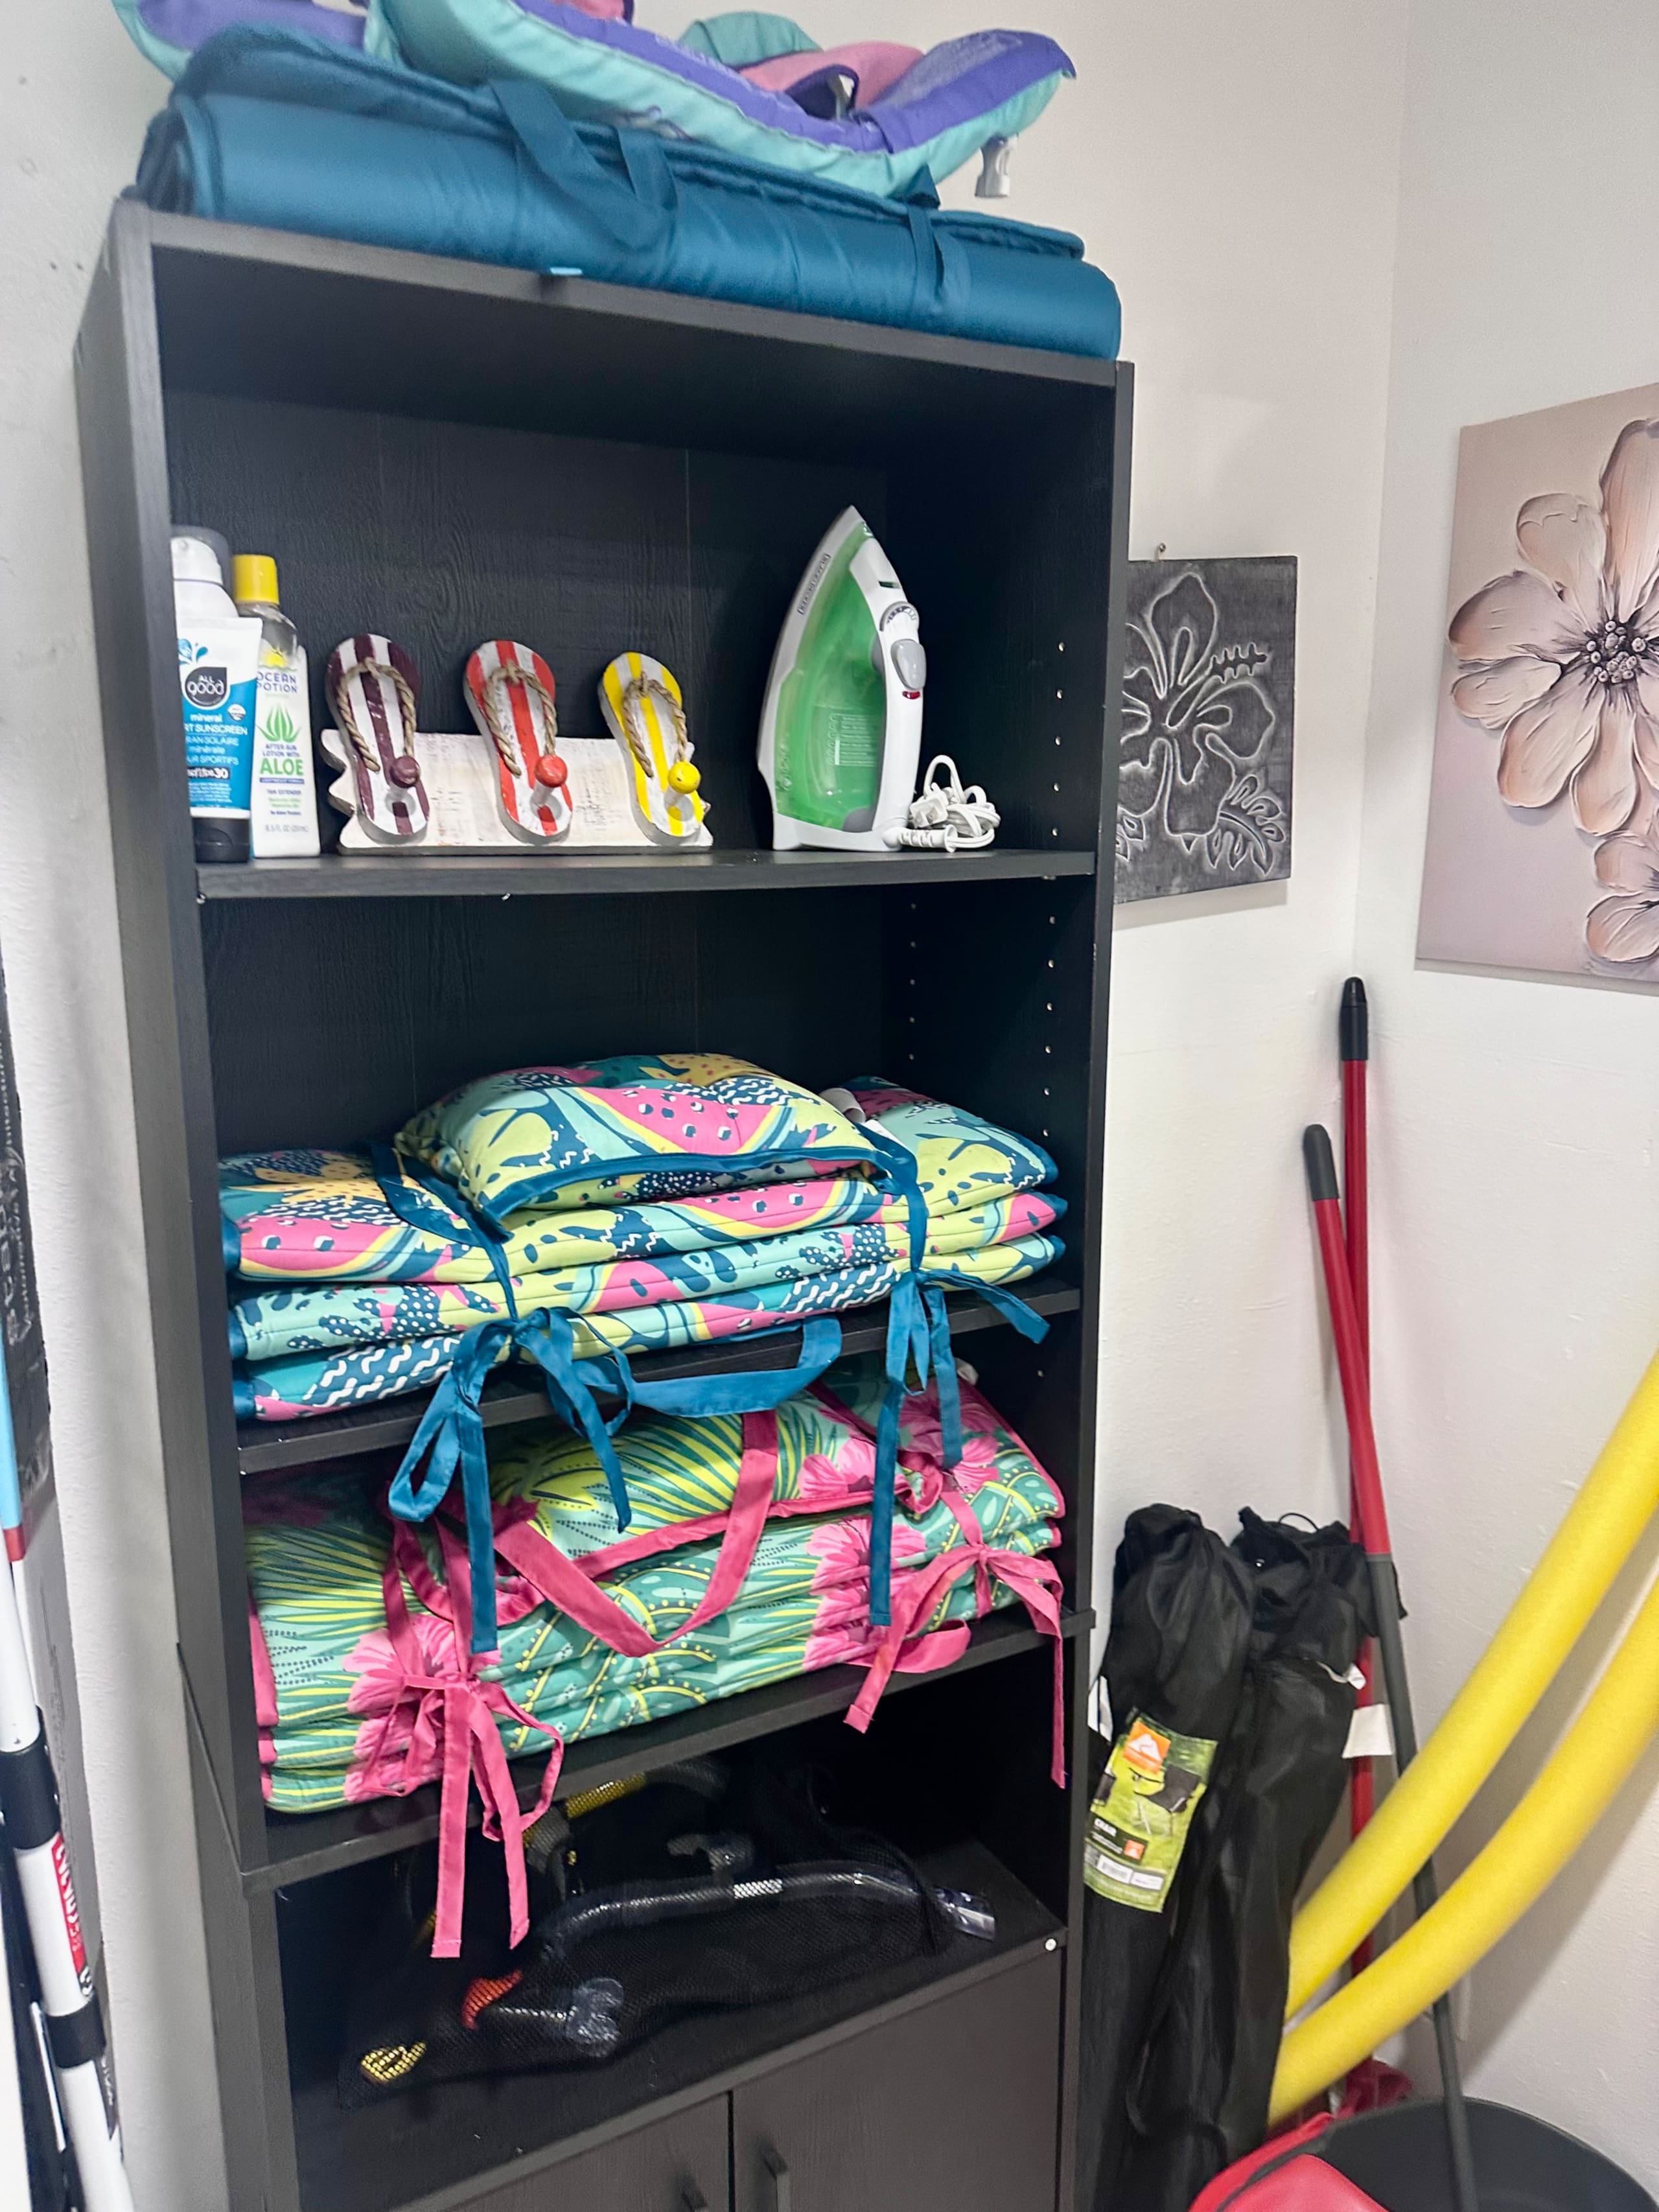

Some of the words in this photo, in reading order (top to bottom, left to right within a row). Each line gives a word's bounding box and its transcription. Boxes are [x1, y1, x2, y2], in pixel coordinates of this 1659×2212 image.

[198, 675, 215, 684] ALL
[256, 671, 296, 684] OCEAN
[190, 714, 223, 722] mineral
[195, 724, 248, 735] SUNSCREEN
[260, 758, 304, 776] ALOE
